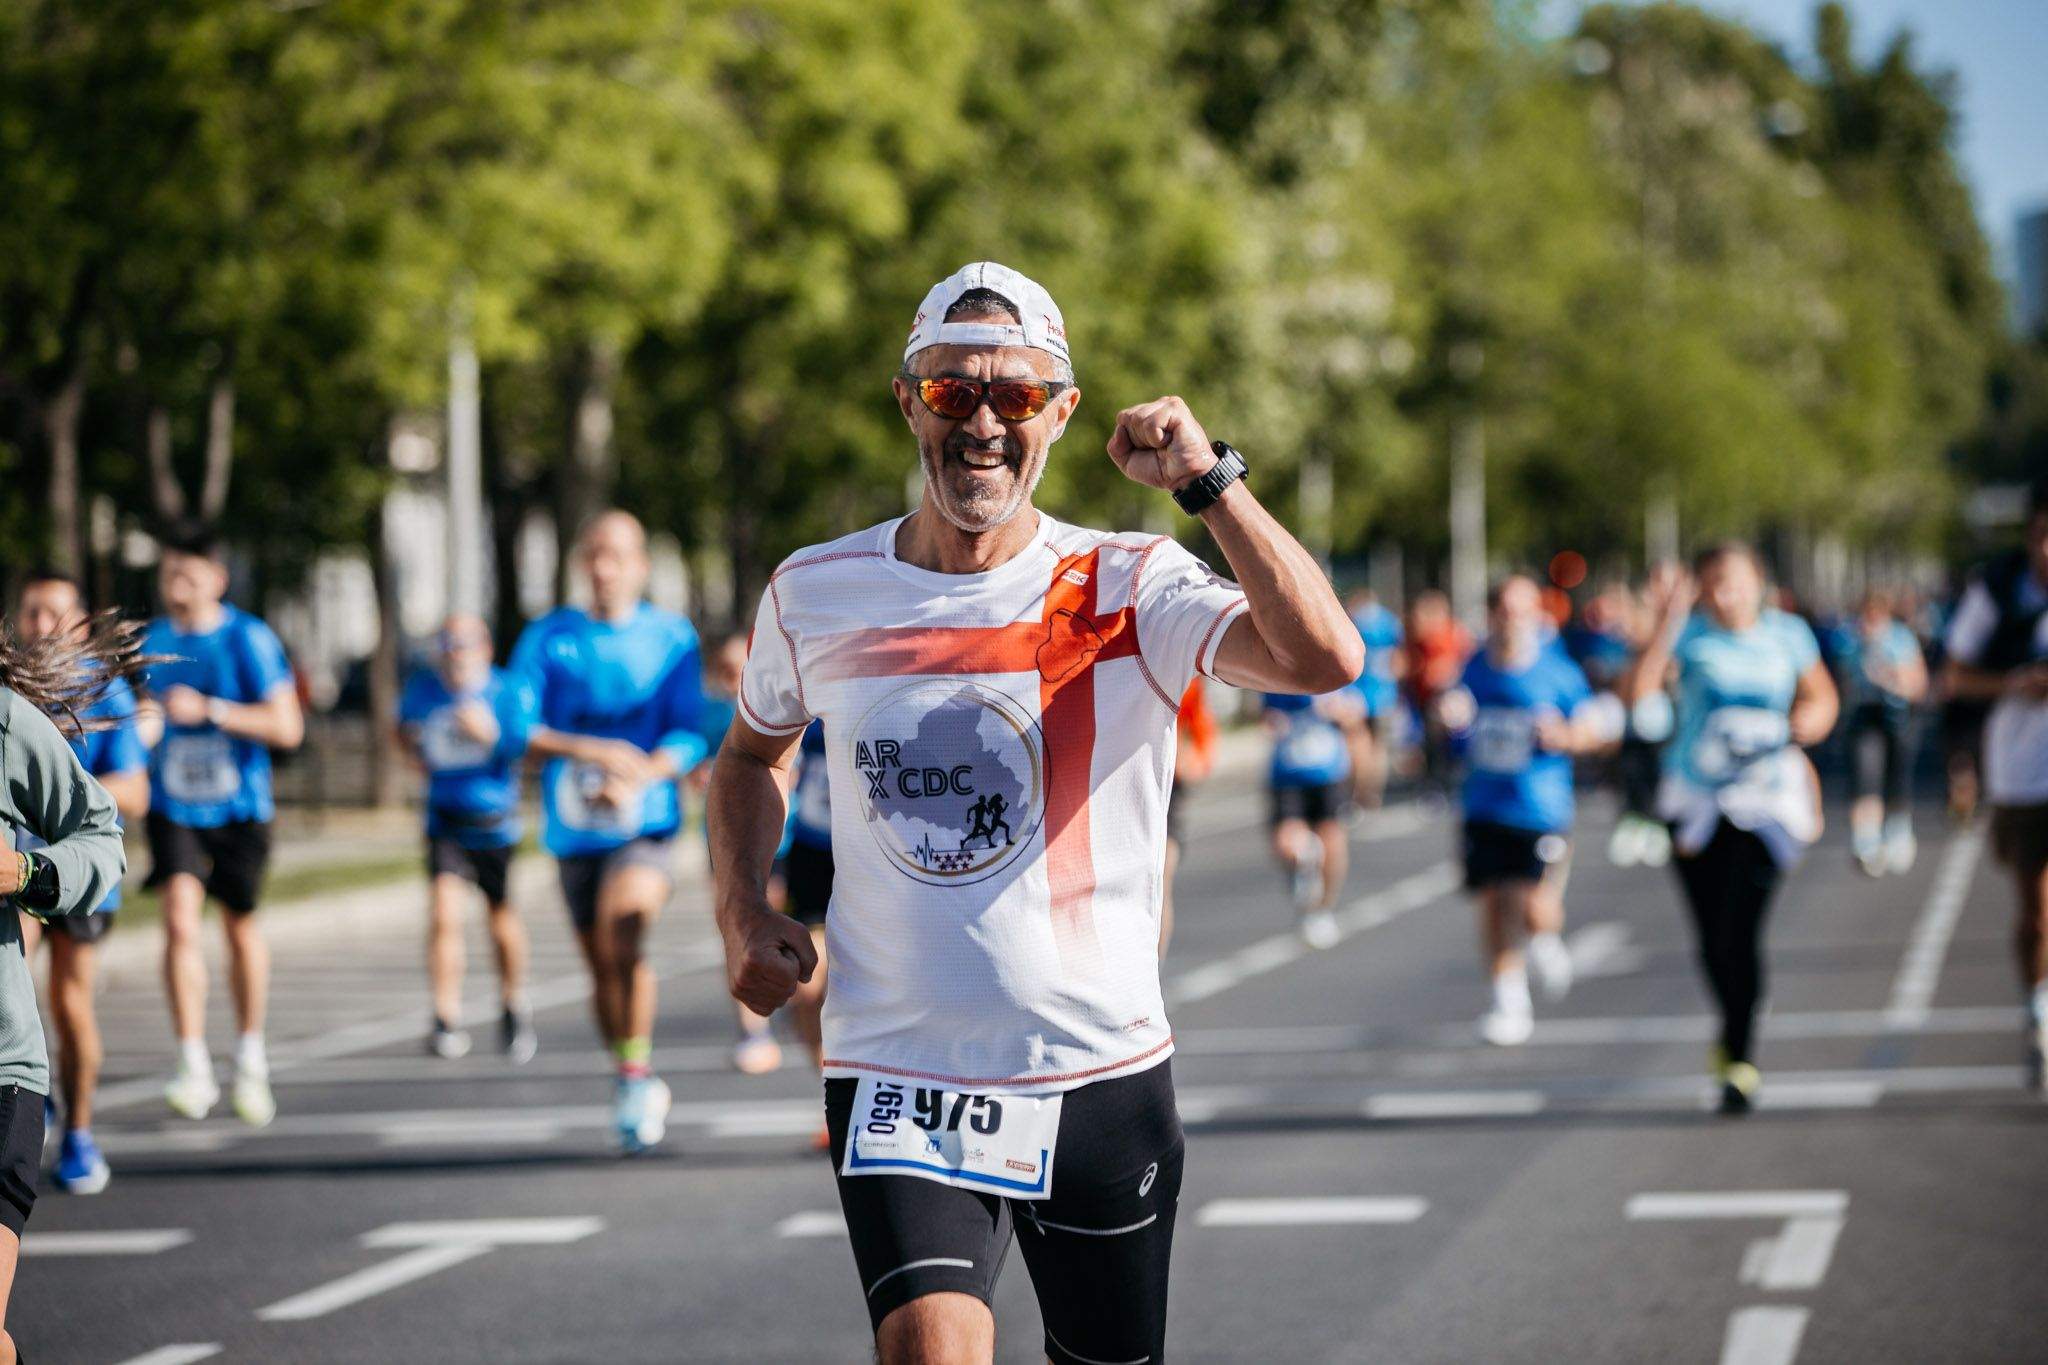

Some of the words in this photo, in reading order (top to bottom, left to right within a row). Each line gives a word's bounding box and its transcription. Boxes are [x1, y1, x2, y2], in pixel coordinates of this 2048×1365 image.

[855, 739, 902, 769] AR
[864, 770, 890, 800] X
[897, 765, 975, 799] CDC
